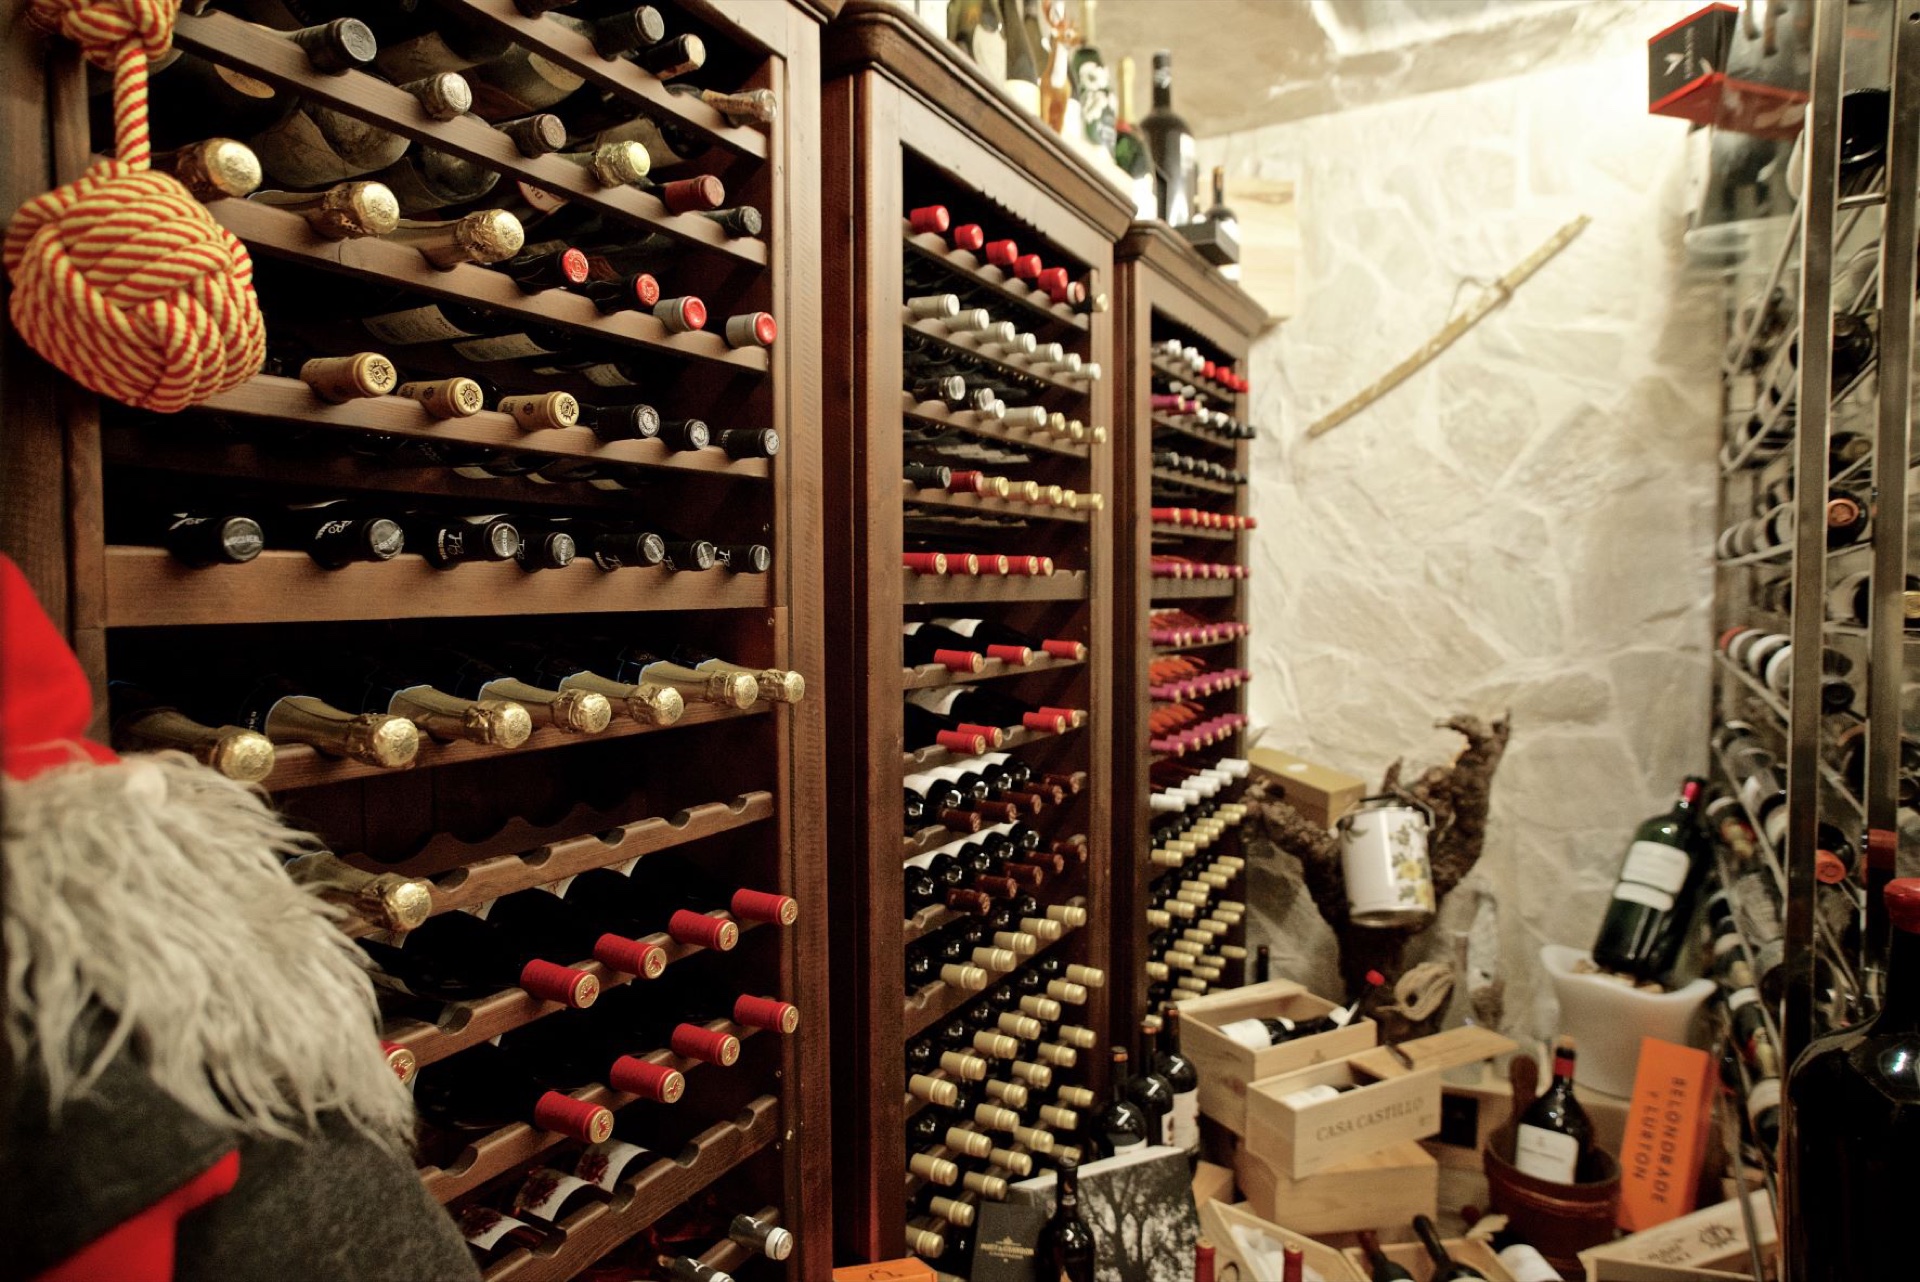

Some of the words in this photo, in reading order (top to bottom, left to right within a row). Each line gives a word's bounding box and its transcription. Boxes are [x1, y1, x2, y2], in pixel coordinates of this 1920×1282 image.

[1316, 1118, 1353, 1141] CASA
[1356, 1096, 1424, 1129] CASTILLO
[1633, 1104, 1658, 1179] LURTON
[1651, 1077, 1687, 1203] BELONDRADE
